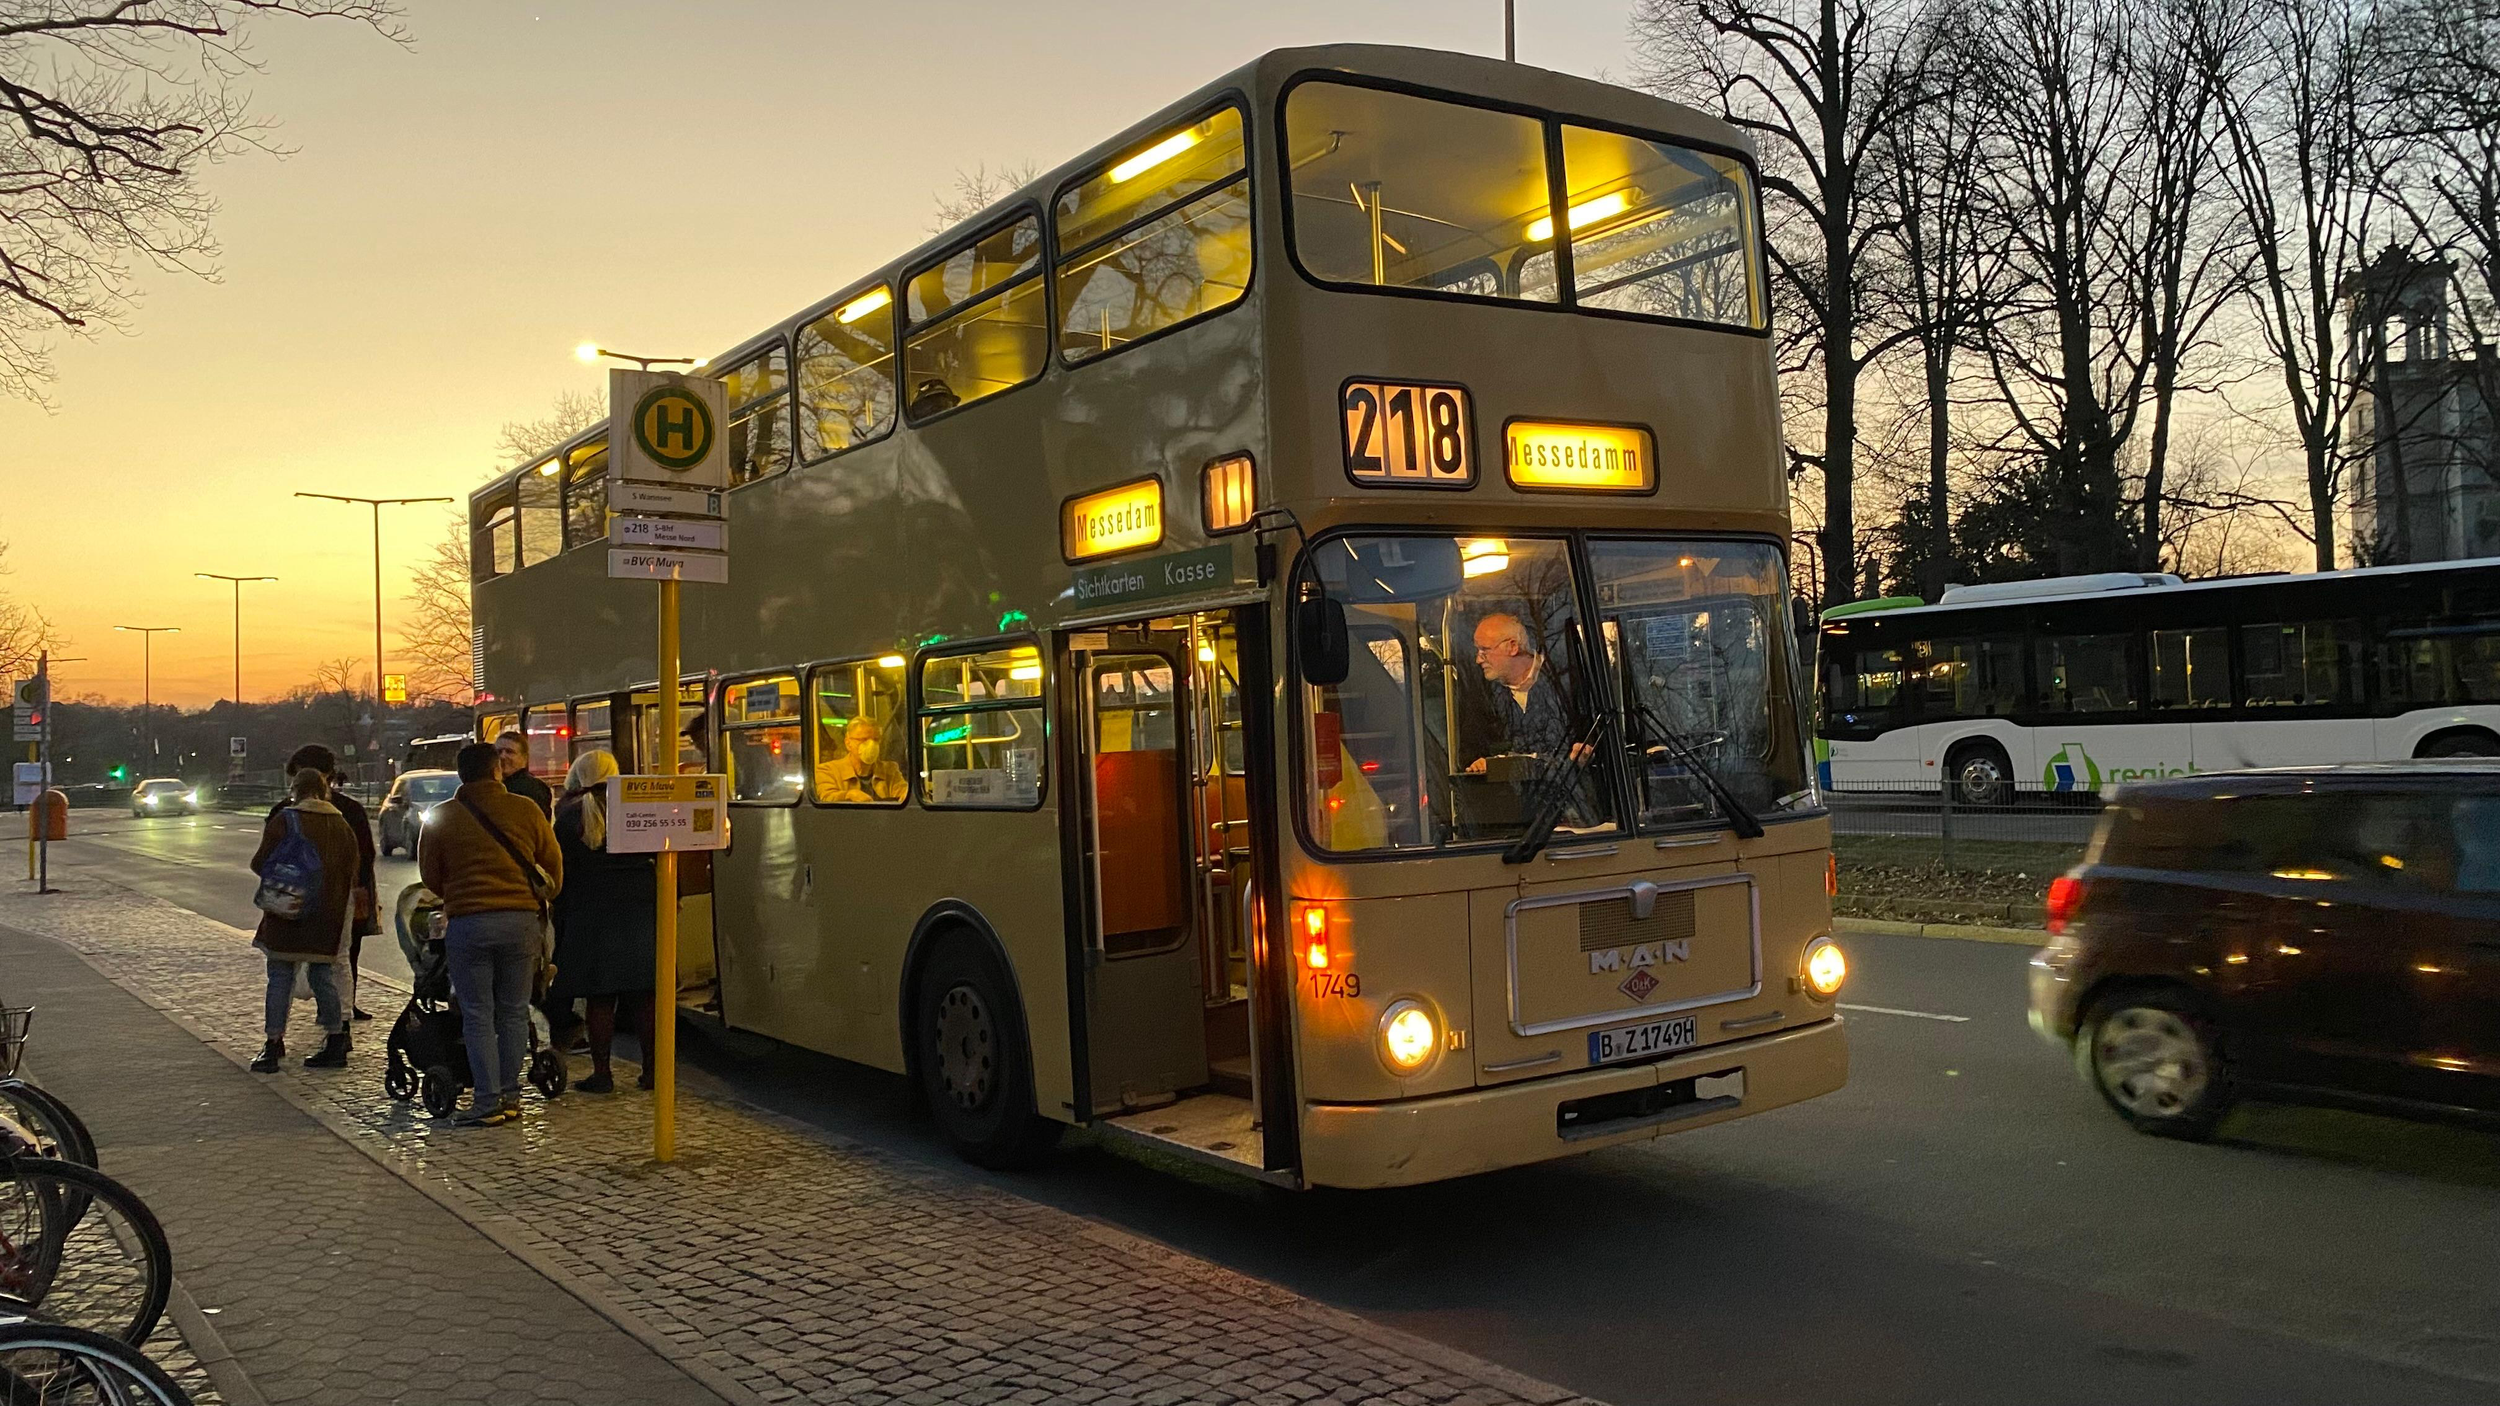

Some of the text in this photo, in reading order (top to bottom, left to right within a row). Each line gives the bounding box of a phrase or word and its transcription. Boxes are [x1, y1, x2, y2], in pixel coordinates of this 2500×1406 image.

[656, 405, 694, 450] H
[1346, 387, 1462, 474] 218
[639, 493, 672, 501] Wannsee
[710, 497, 719, 515] B
[632, 523, 649, 533] 218
[1077, 503, 1155, 543] Messedam
[654, 533, 677, 541] Messe
[631, 556, 684, 568] BVG Muva
[1077, 562, 1215, 599] Sichtkarten Kasse
[626, 782, 647, 791] BVG
[626, 818, 687, 828] 030 256 55 5 55
[1310, 973, 1361, 999] 1749
[1601, 1034, 1613, 1058] B
